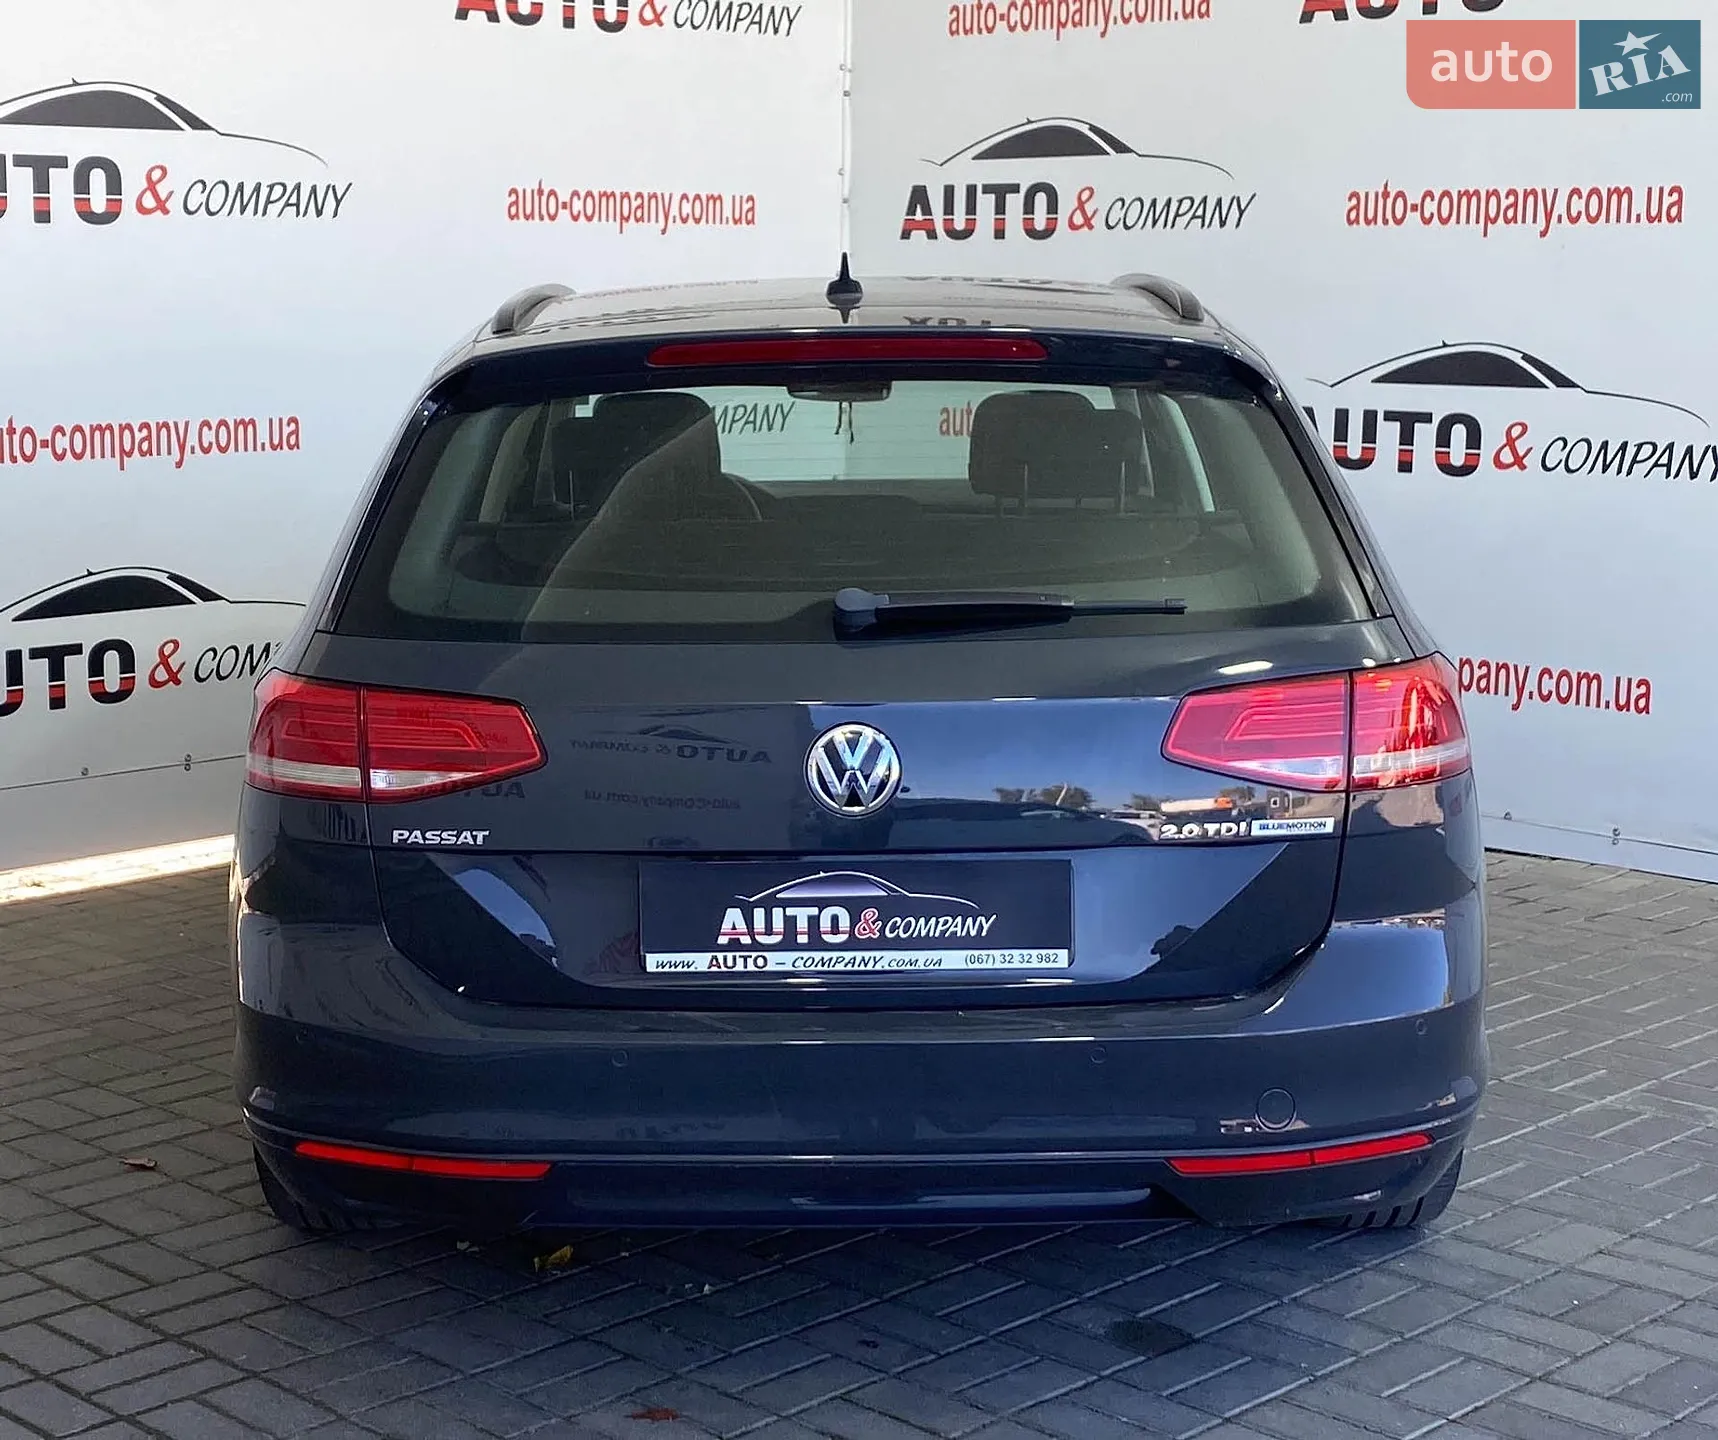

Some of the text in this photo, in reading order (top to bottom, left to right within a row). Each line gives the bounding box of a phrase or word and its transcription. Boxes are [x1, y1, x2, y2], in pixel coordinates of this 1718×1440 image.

[673, 0, 801, 37] COMPANY
[135, 164, 174, 216] &
[182, 179, 353, 219] COMPANY
[507, 178, 756, 235] auto-company.com.ua
[900, 182, 1257, 241] AUTO & COMPANY
[1346, 179, 1684, 238] auto-company.com.ua
[1302, 406, 1718, 483] UTO & COMPANY
[148, 638, 186, 690] &
[391, 829, 490, 845] PASSAT
[1160, 823, 1200, 839] 2.0
[717, 907, 997, 944] AUTO & COMPANY
[964, 953, 1058, 966] (067) 32 32 982
